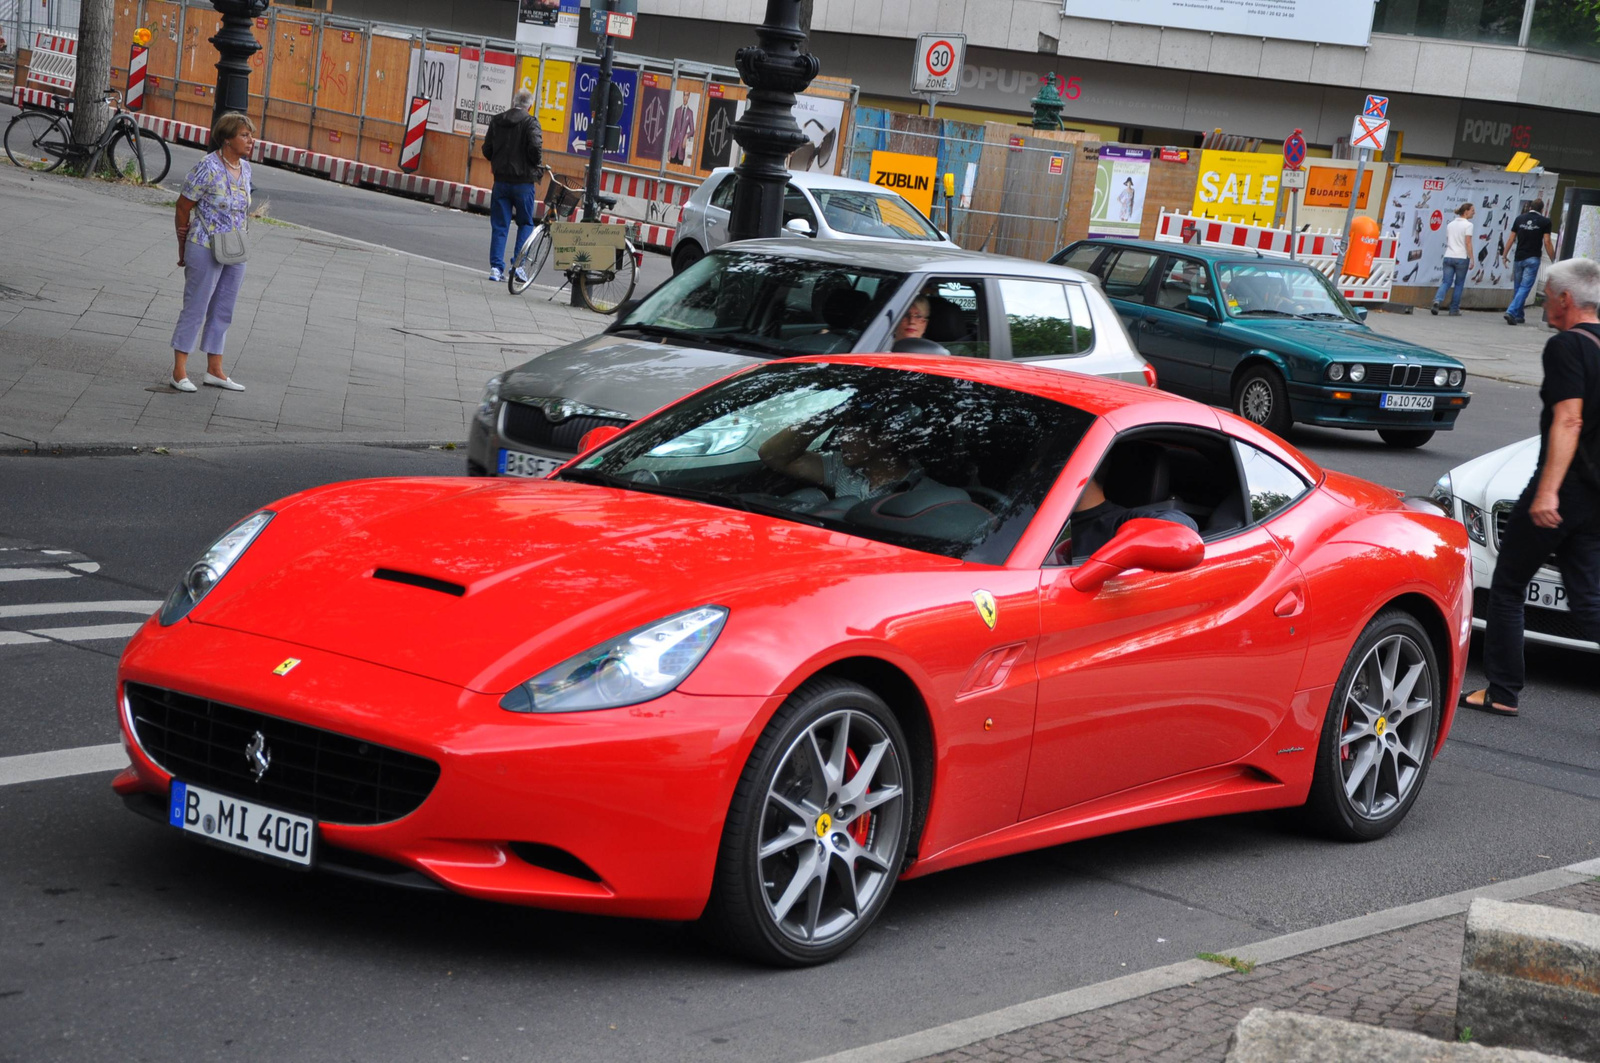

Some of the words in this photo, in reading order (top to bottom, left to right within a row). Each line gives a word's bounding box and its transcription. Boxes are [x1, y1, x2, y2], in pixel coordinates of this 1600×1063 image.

[932, 50, 949, 67] 30
[925, 78, 948, 89] ZONE
[797, 101, 809, 110] look
[875, 171, 929, 191] ZÜBLIN
[1425, 181, 1443, 190] SALE
[1198, 170, 1279, 207] SALE
[1310, 187, 1366, 199] BUDAPESR
[553, 223, 584, 235] Ristorante
[591, 224, 620, 236] Trattoria
[958, 298, 976, 308] 2285
[1387, 396, 1394, 407] B
[1412, 397, 1432, 408] 7426
[507, 453, 516, 472] B
[1527, 582, 1541, 602] B
[174, 808, 181, 818] D
[185, 790, 200, 825] B
[217, 799, 249, 842] MI
[257, 813, 309, 858] 400
